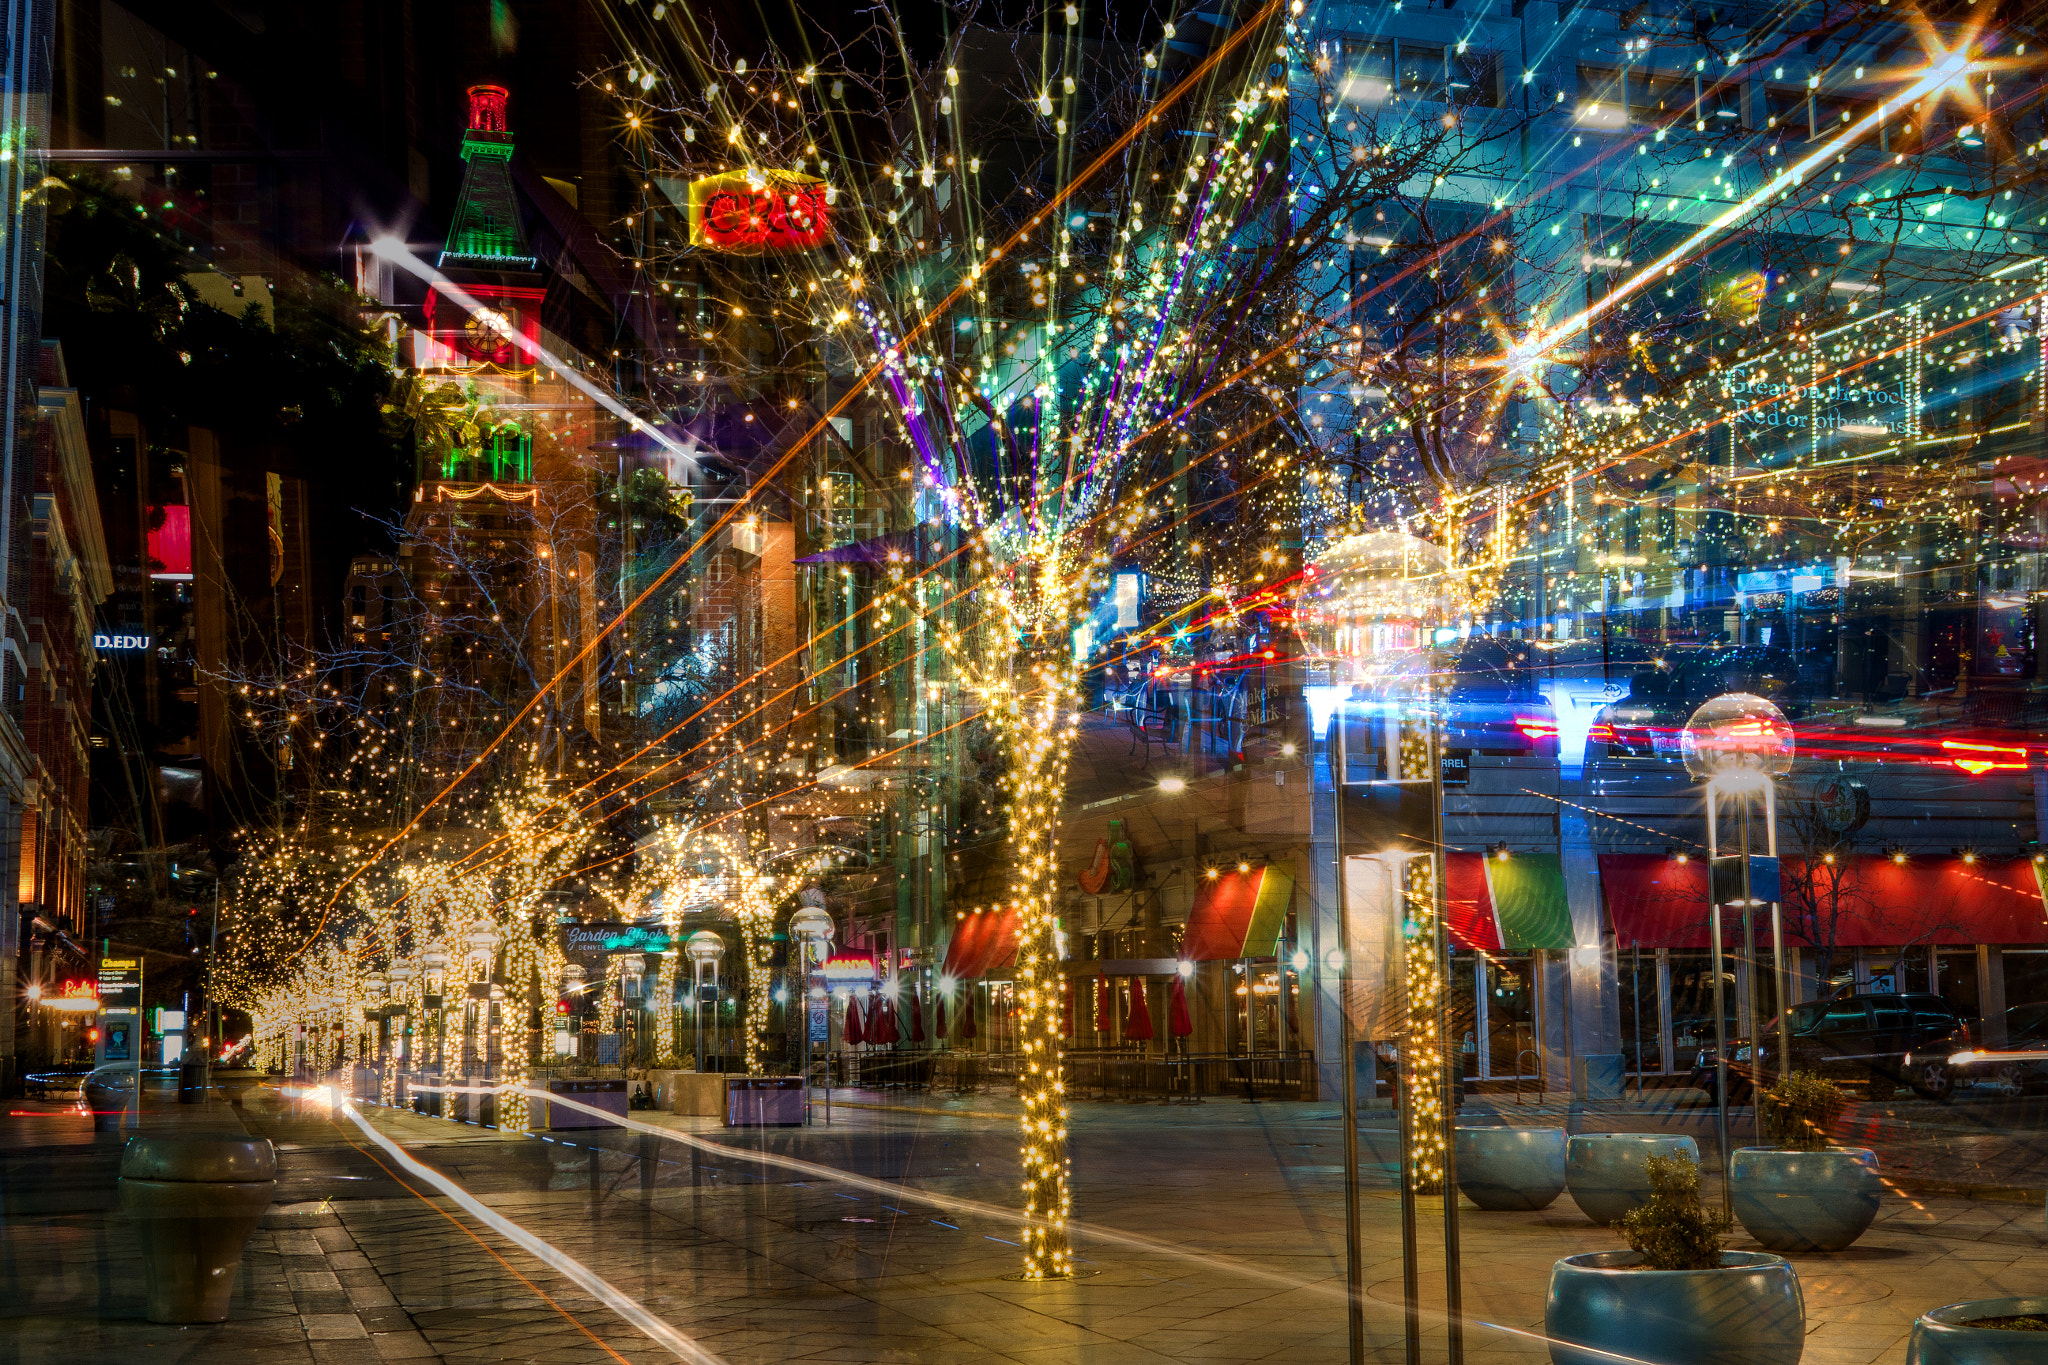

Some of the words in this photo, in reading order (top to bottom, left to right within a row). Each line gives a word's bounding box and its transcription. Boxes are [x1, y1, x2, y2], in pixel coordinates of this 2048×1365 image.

[1796, 385, 1820, 399] on
[1828, 377, 1860, 401] the
[1734, 399, 1779, 426] Red
[1787, 414, 1808, 428] or
[94, 635, 150, 649] D.EDU
[566, 927, 617, 951] Garden
[625, 926, 664, 942] Block
[102, 959, 136, 969] Champa
